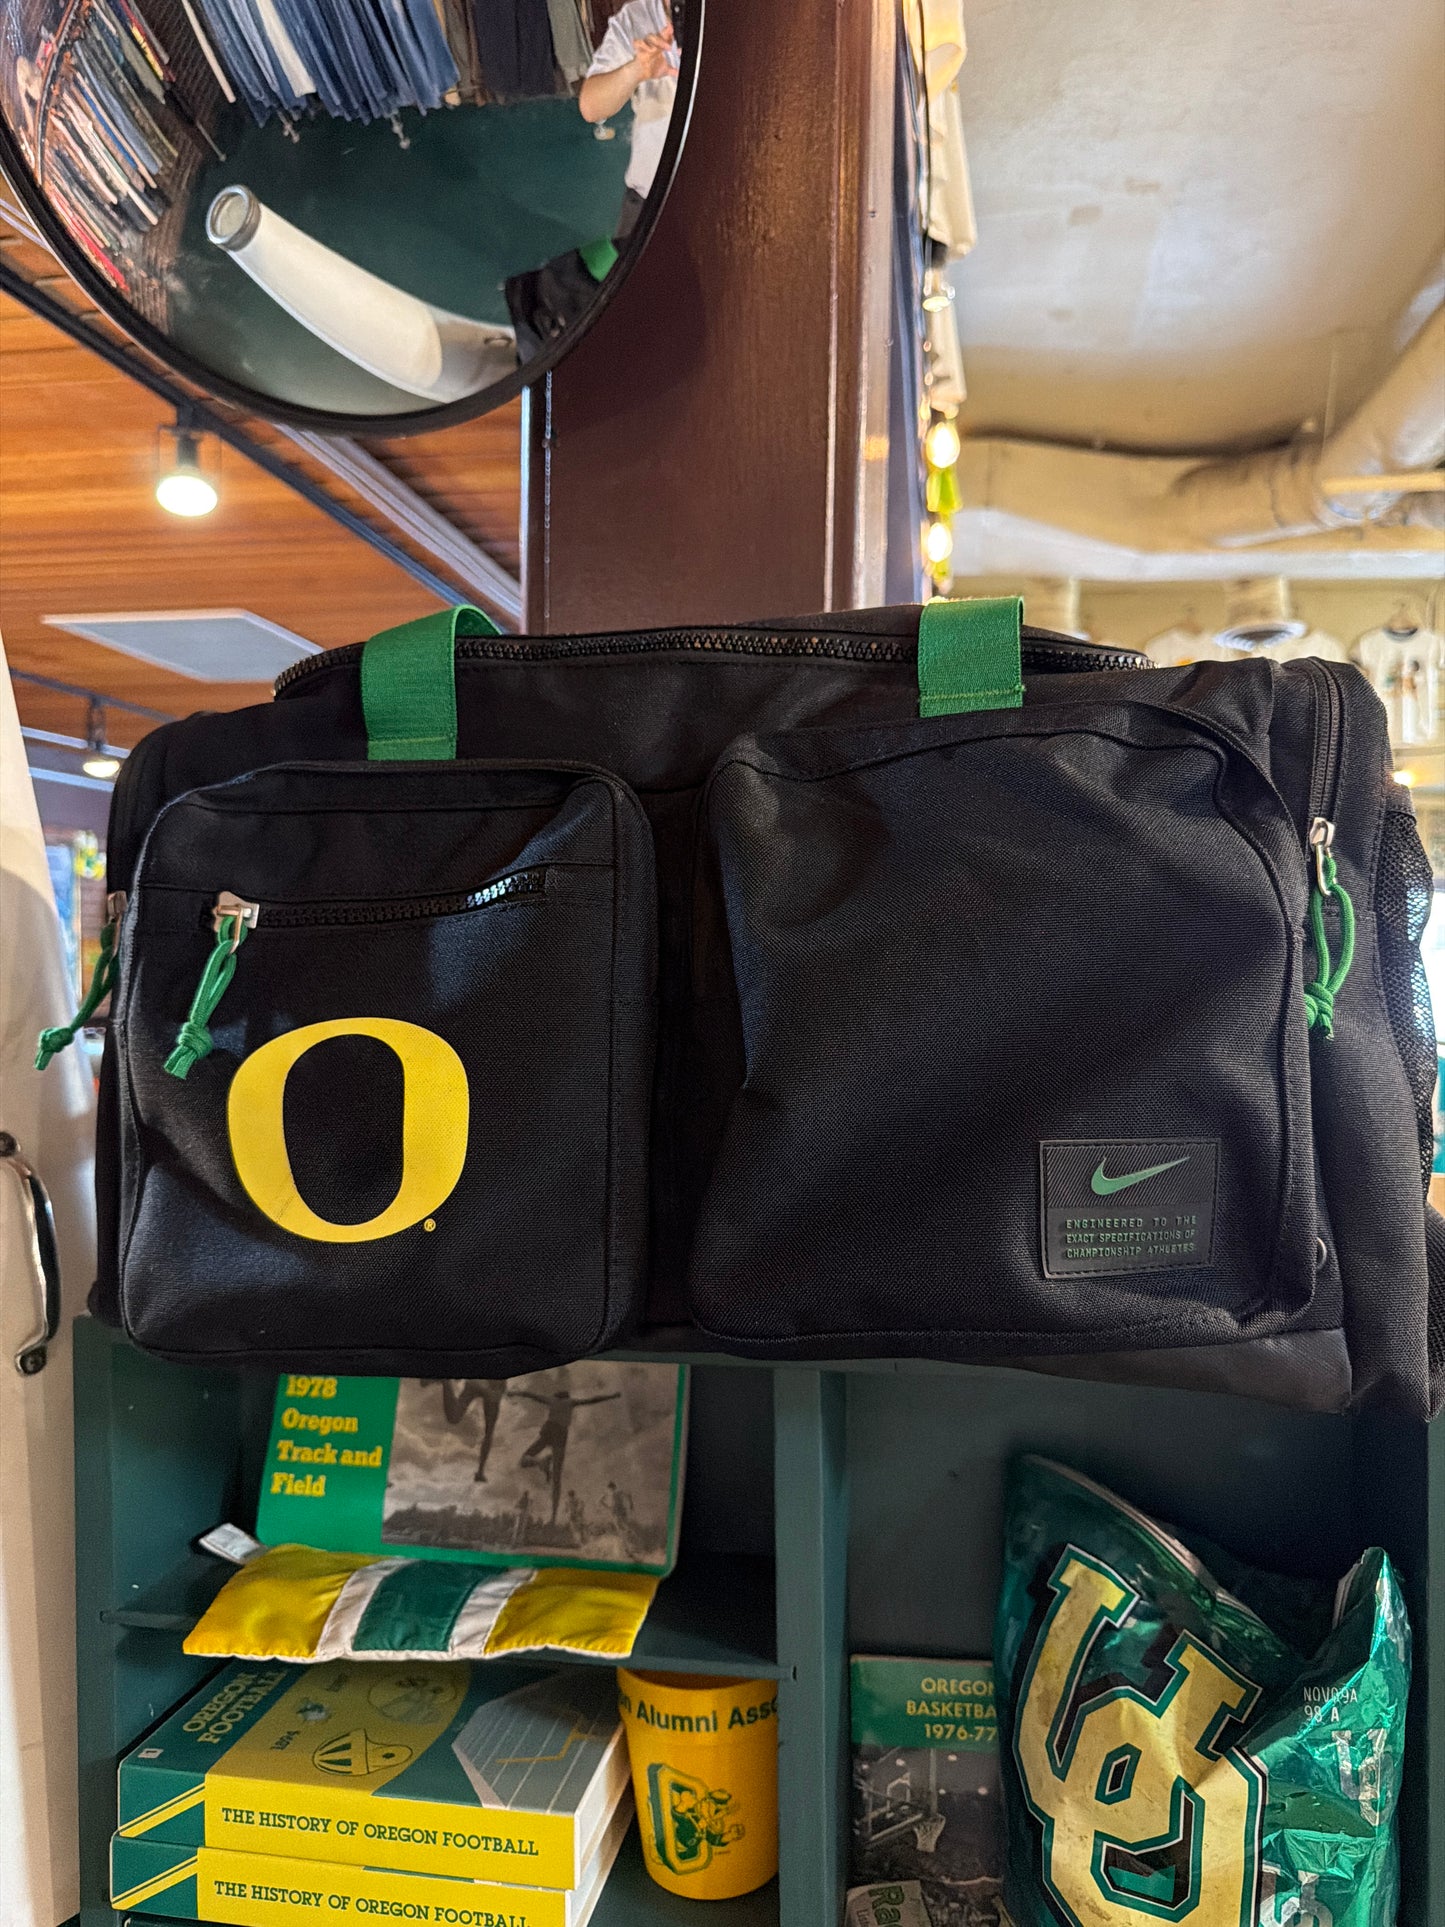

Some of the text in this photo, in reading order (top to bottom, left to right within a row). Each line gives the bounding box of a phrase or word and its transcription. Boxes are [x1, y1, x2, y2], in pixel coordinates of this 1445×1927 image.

[228, 1017, 470, 1243] O
[1066, 1215, 1197, 1229] ENGINEERED TO THE
[1066, 1229, 1195, 1244] EXACT SPECIFICATIONS OF
[1067, 1242, 1195, 1258] CHAMPIONSHIP ATHLETES
[286, 1375, 338, 1399] 1978
[282, 1407, 359, 1436] Oregon
[277, 1439, 383, 1468] Track and
[270, 1471, 327, 1497] Field
[183, 1672, 258, 1733] OREGON
[197, 1669, 289, 1744] FOOTBALL
[636, 1700, 718, 1732] Alumni
[1330, 1706, 1340, 1722] A
[924, 1723, 998, 1741] 1976-77
[221, 1807, 539, 1856] THE HISTORY OF OREGON FOOTBALL
[214, 1880, 532, 1927] THE HISTORY OF OREGON FOOTBALL
